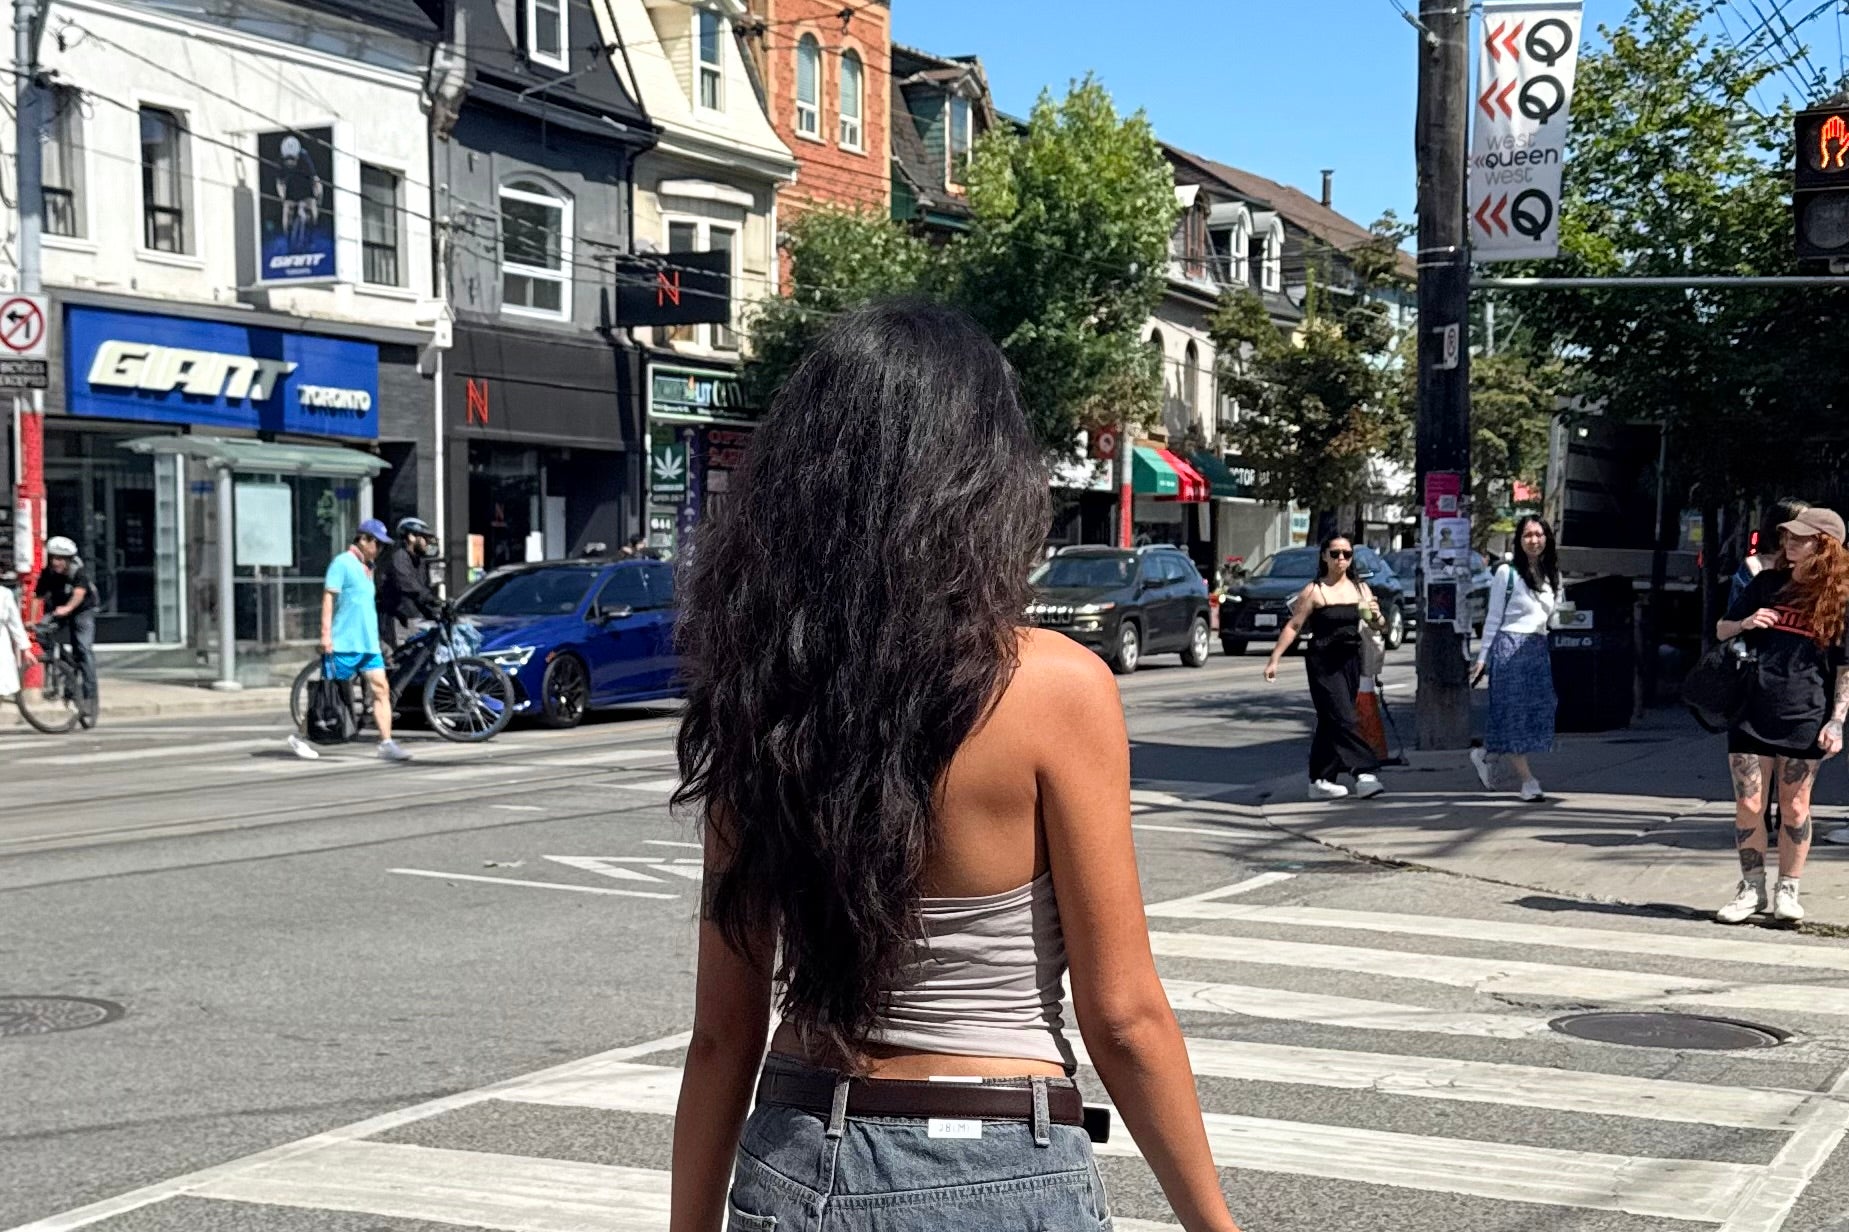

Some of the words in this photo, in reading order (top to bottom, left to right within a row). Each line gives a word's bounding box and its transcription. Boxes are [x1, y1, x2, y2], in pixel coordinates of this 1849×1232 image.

[1487, 132, 1537, 151] west
[1485, 167, 1534, 186] west
[269, 252, 326, 269] GIANT
[658, 271, 680, 307] N
[88, 339, 298, 400] GIANT
[297, 384, 371, 411] TORONTO
[466, 377, 489, 424] N
